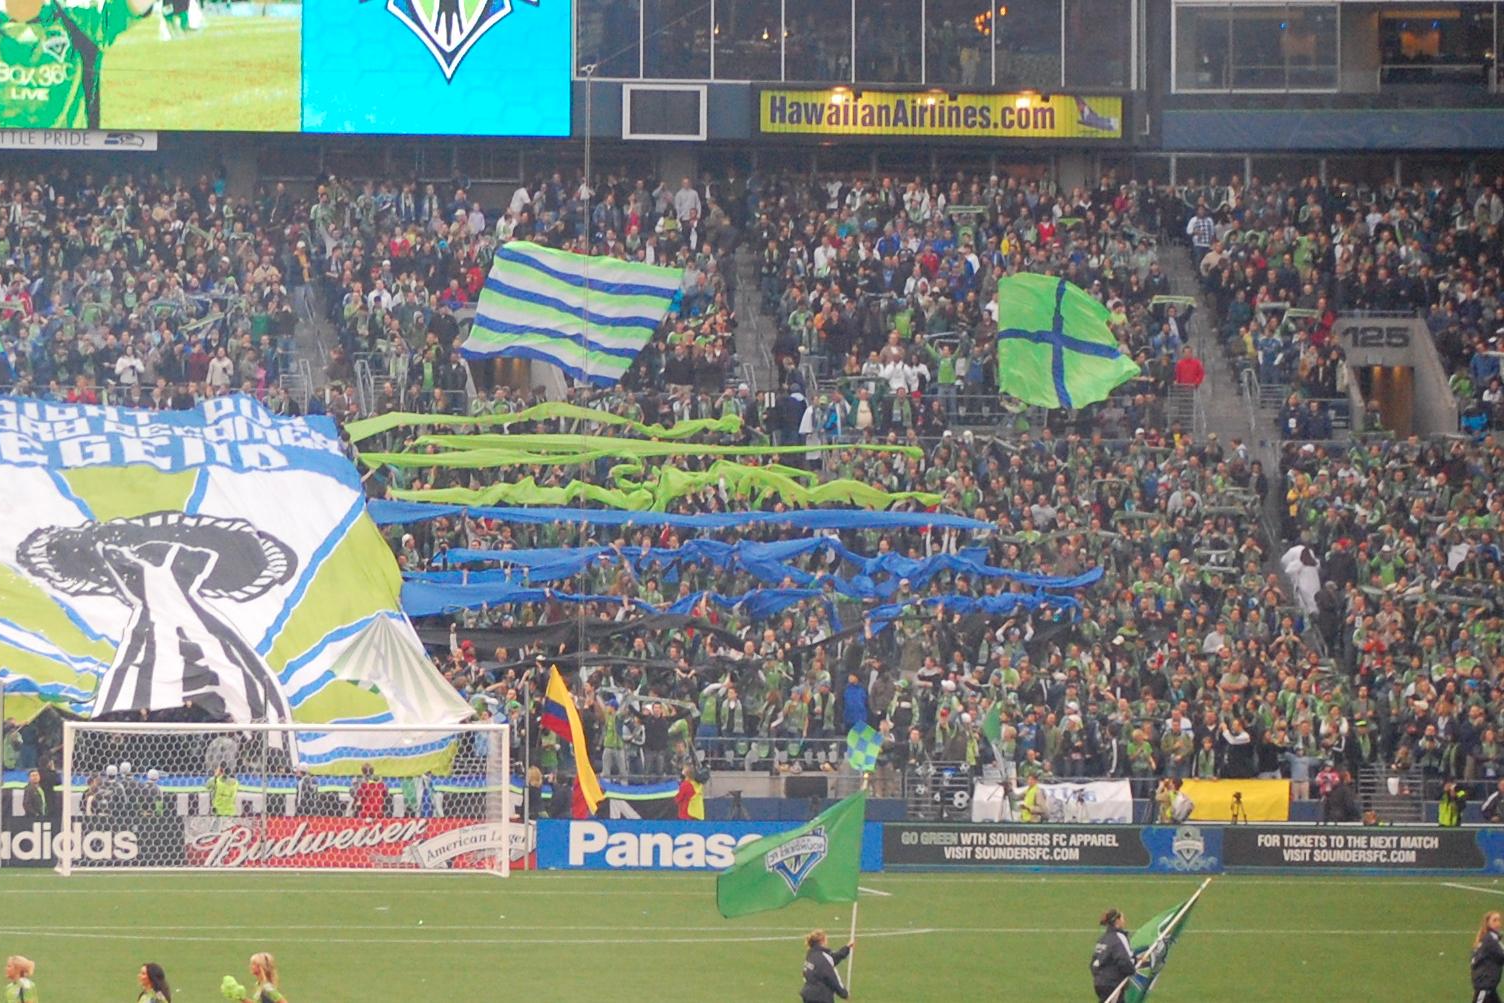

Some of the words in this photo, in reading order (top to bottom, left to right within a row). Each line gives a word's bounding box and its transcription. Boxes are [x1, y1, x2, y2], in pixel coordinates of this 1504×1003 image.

[11, 87, 50, 101] LIVE
[770, 94, 1056, 130] HawaiianAirlines.com
[43, 132, 91, 146] PRIDE
[1342, 326, 1411, 348] 125
[192, 817, 428, 867] Budweiser
[425, 833, 487, 860] American
[901, 831, 918, 845] GO
[920, 832, 958, 845] GREEN
[989, 832, 1050, 847] SOUNDERS
[1052, 833, 1067, 847] FC
[1069, 834, 1119, 848] APPAREL
[1257, 834, 1280, 847] FOR
[1282, 834, 1327, 848] TICKETS
[1329, 835, 1344, 848] TO
[1346, 836, 1368, 848] THE
[1370, 836, 1398, 849] NEXT
[1400, 836, 1439, 849] MATCH
[944, 846, 973, 860] VISIT
[975, 846, 1080, 861] SOUNDERSFC.COM
[1283, 849, 1311, 862] VISIT
[1313, 849, 1416, 863] SOUNDERSFC.COM
